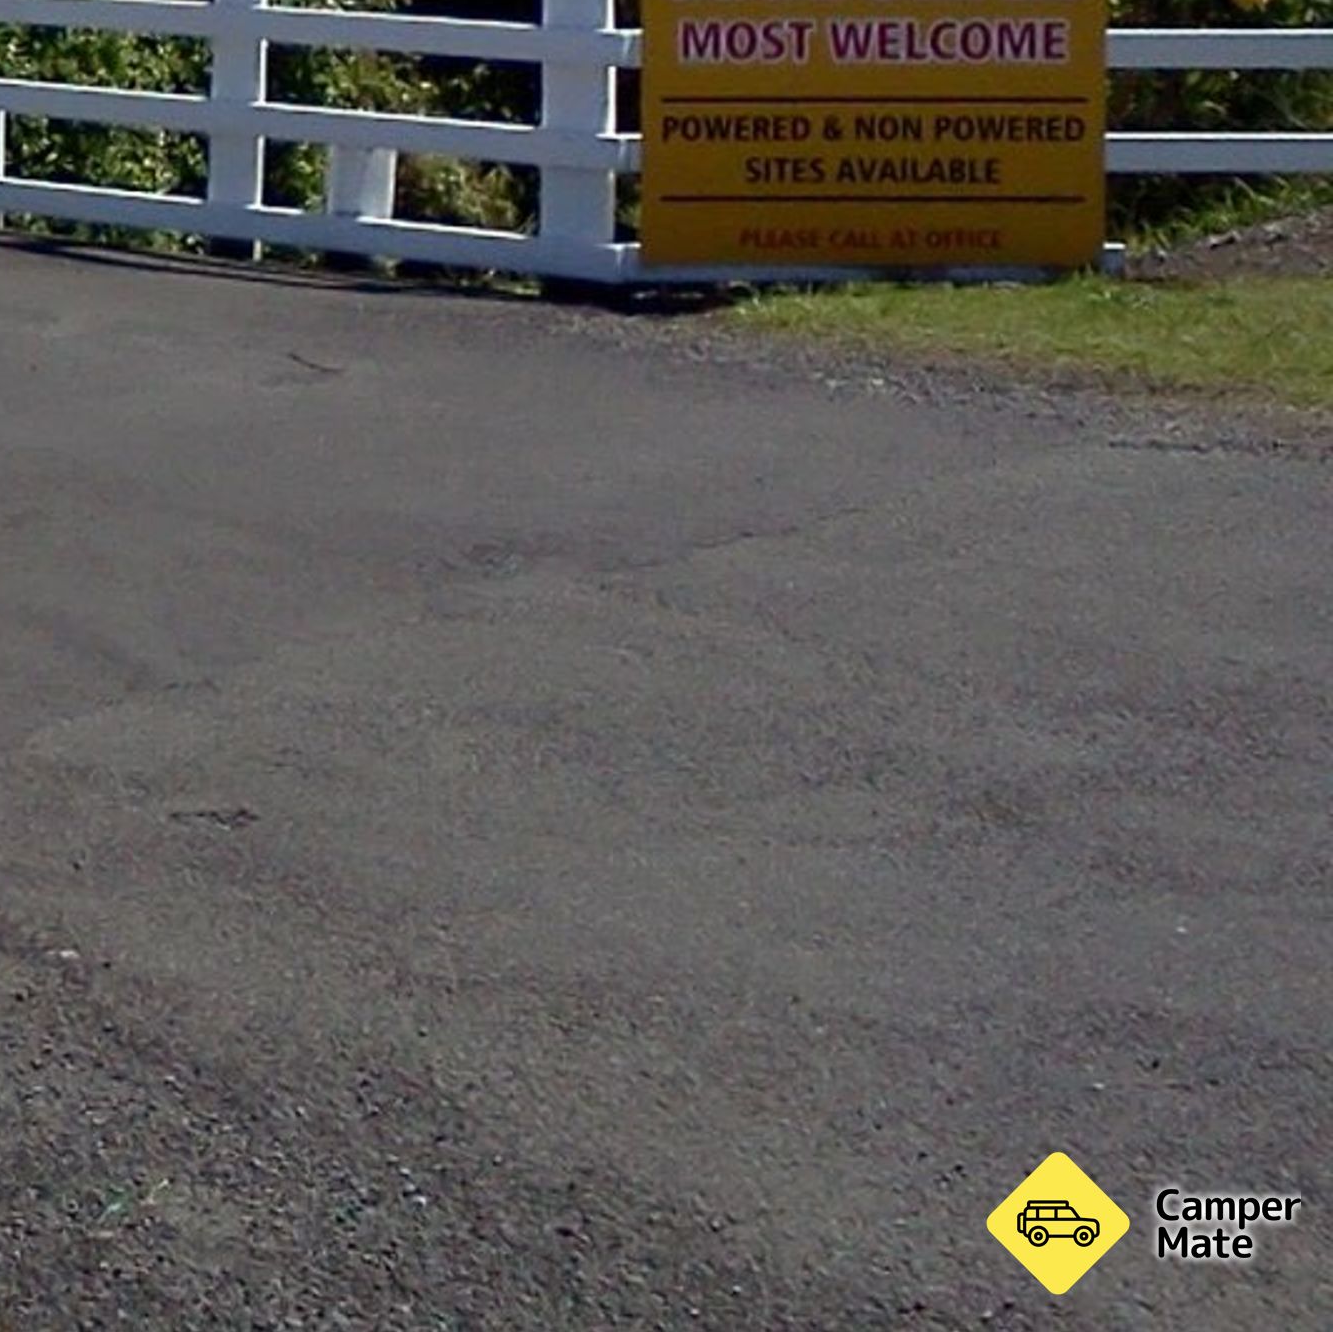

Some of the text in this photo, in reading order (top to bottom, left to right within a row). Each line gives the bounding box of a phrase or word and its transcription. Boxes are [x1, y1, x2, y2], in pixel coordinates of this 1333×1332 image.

[679, 20, 1067, 62] MOST WELCOME
[661, 116, 1086, 143] POWERED & NON POWERED
[745, 157, 1001, 184] SITES AVAILABLE
[740, 228, 1000, 249] PLEASE CALL AT OFFICE
